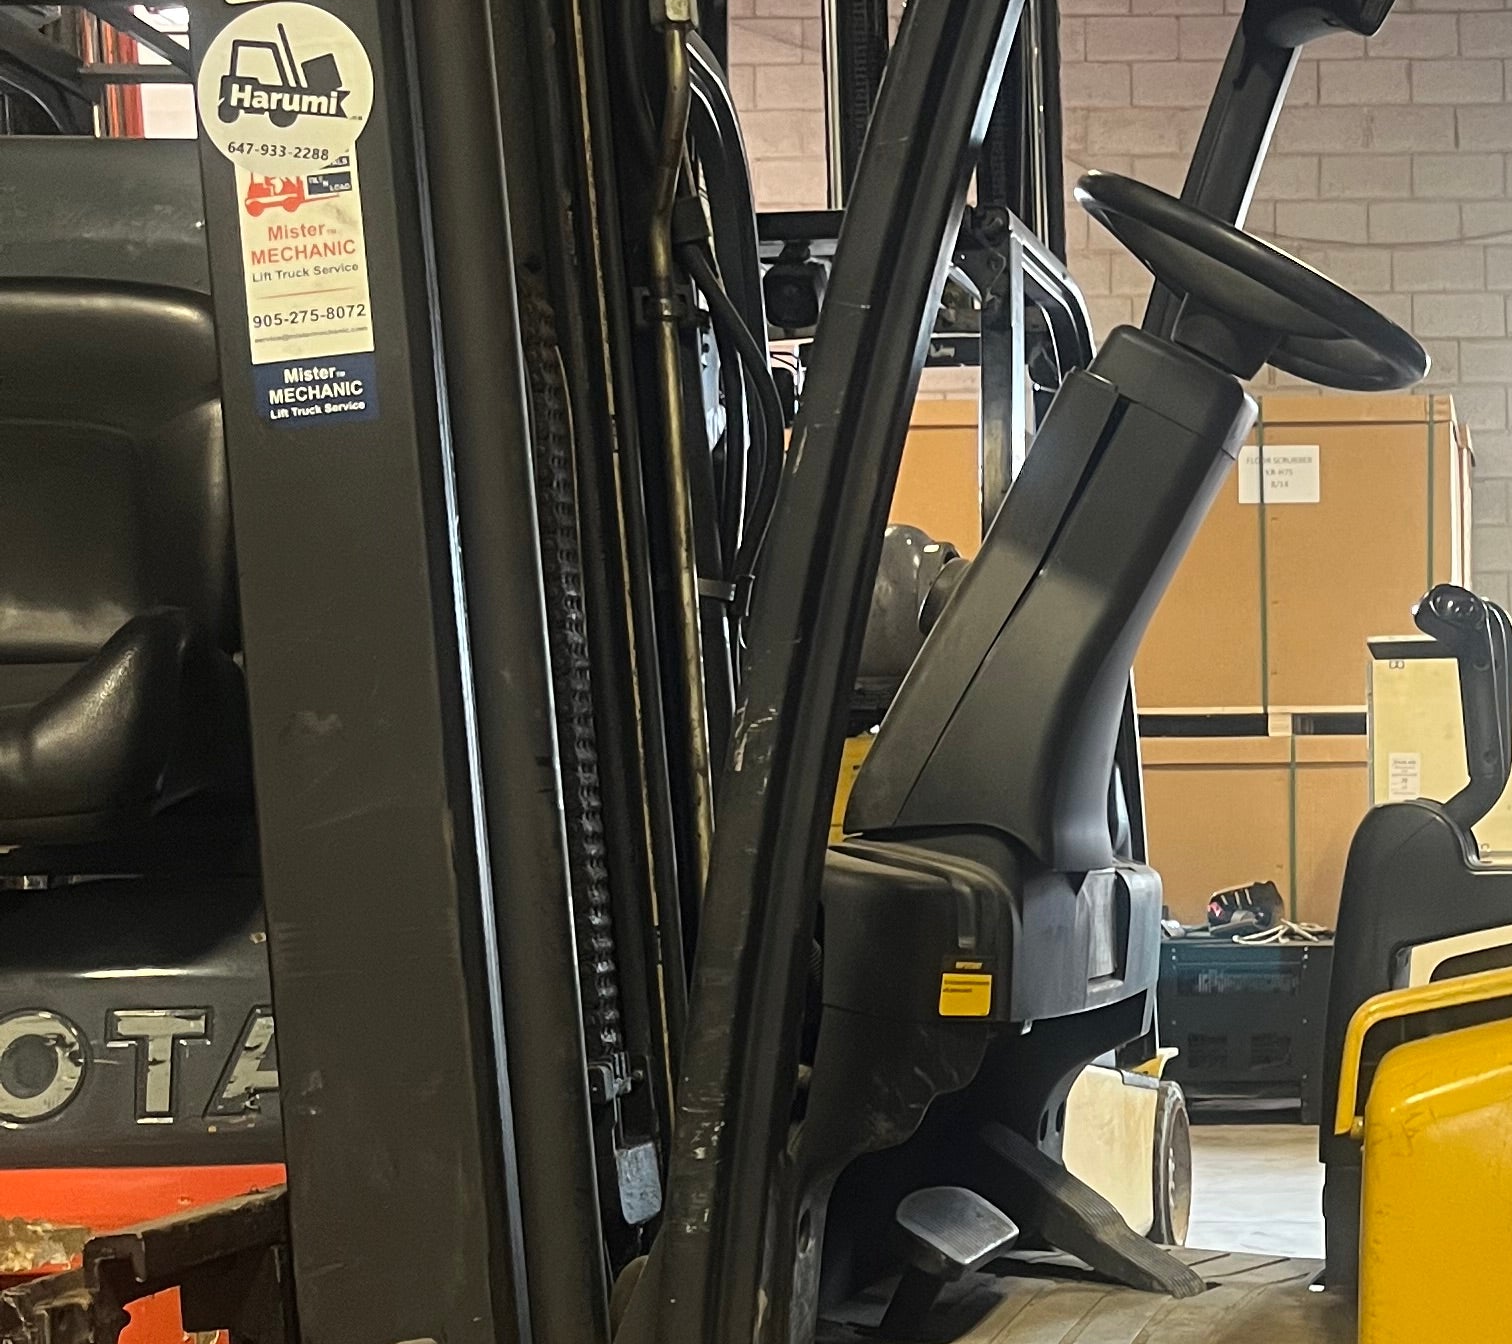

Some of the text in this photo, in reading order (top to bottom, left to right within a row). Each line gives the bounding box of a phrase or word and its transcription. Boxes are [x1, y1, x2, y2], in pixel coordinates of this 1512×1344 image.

[230, 83, 338, 115] Harumi
[227, 141, 330, 160] 647-933-2288
[268, 223, 326, 241] Mister
[251, 239, 357, 266] MECHANIC
[252, 262, 359, 282] Lift Truck Service
[252, 303, 367, 329] 905-275-8072
[283, 366, 336, 384] Mister
[268, 379, 364, 405] MECHANIC
[270, 400, 366, 420] Lift Truck Service
